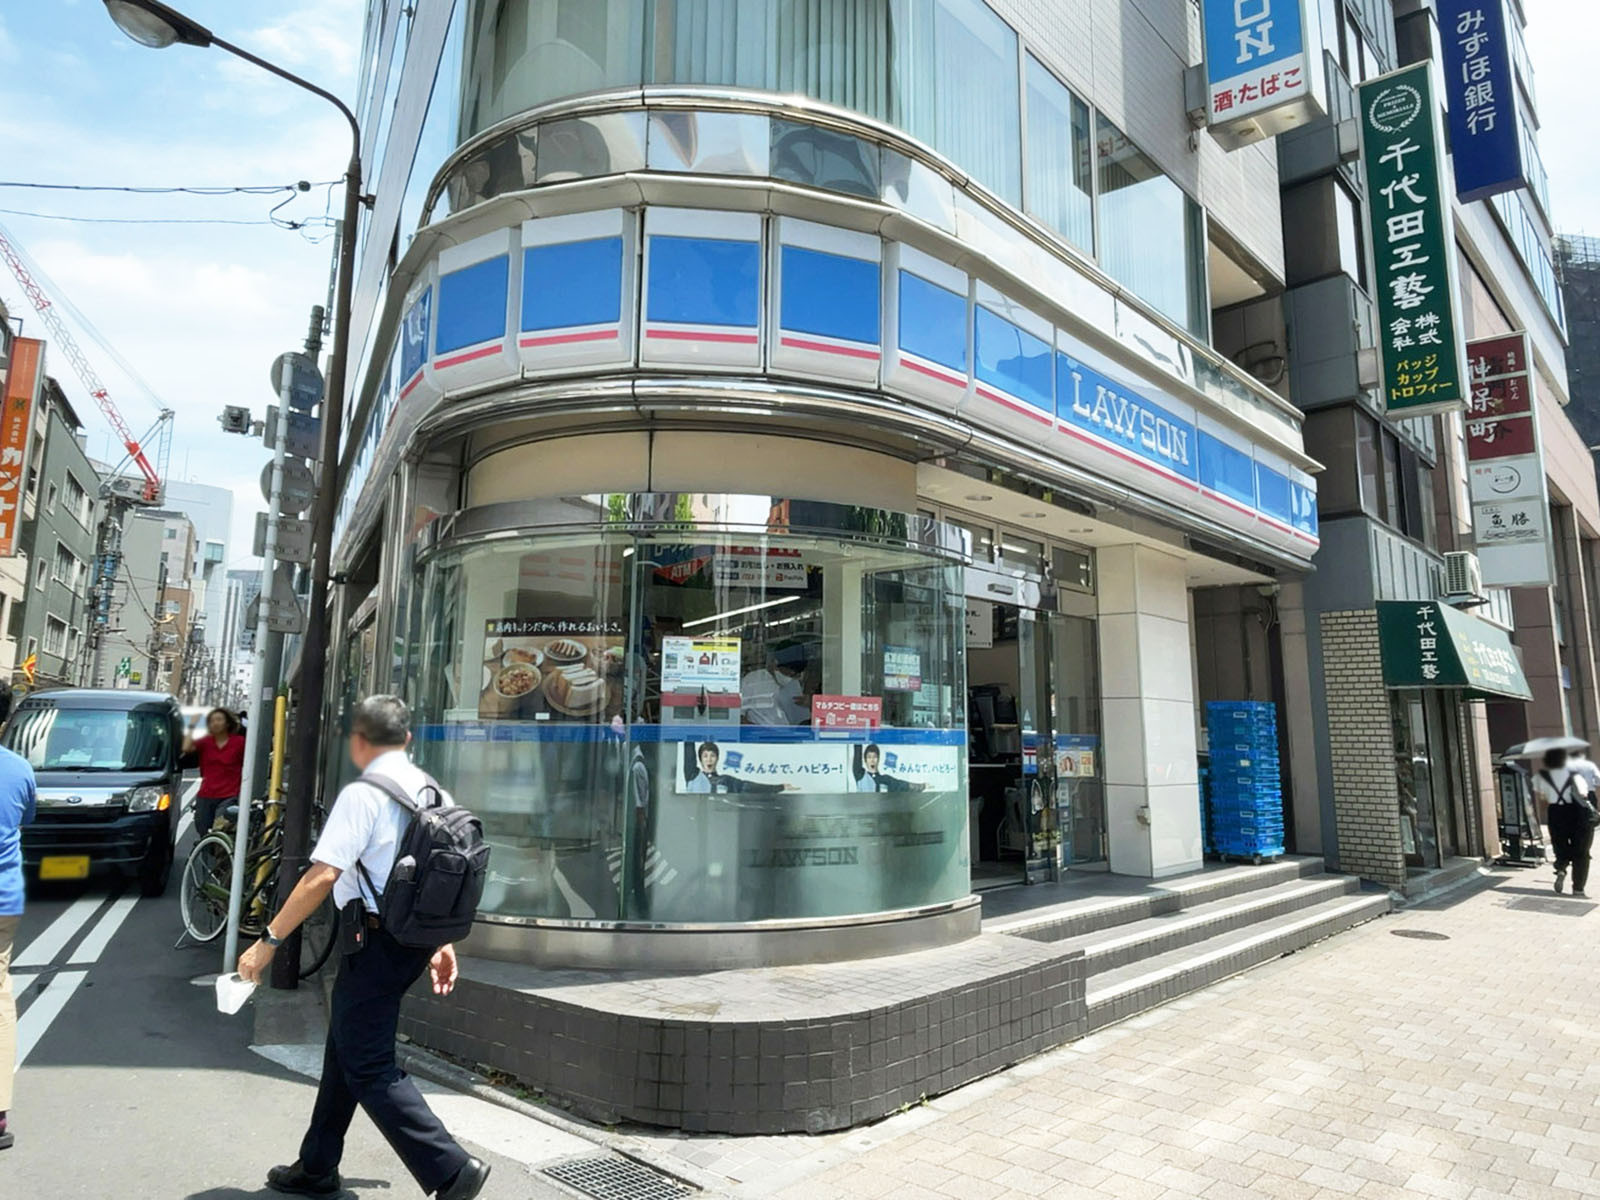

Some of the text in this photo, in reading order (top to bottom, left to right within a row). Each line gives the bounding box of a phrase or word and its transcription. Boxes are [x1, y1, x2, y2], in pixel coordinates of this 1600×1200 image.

[1456, 9, 1497, 135] みずほ銀行
[1214, 67, 1302, 113] 酒・たばこ
[1396, 353, 1437, 372] バッジ
[1397, 366, 1439, 385] カップ
[1391, 382, 1453, 400] トロフィー
[1072, 371, 1189, 466] LAWSON
